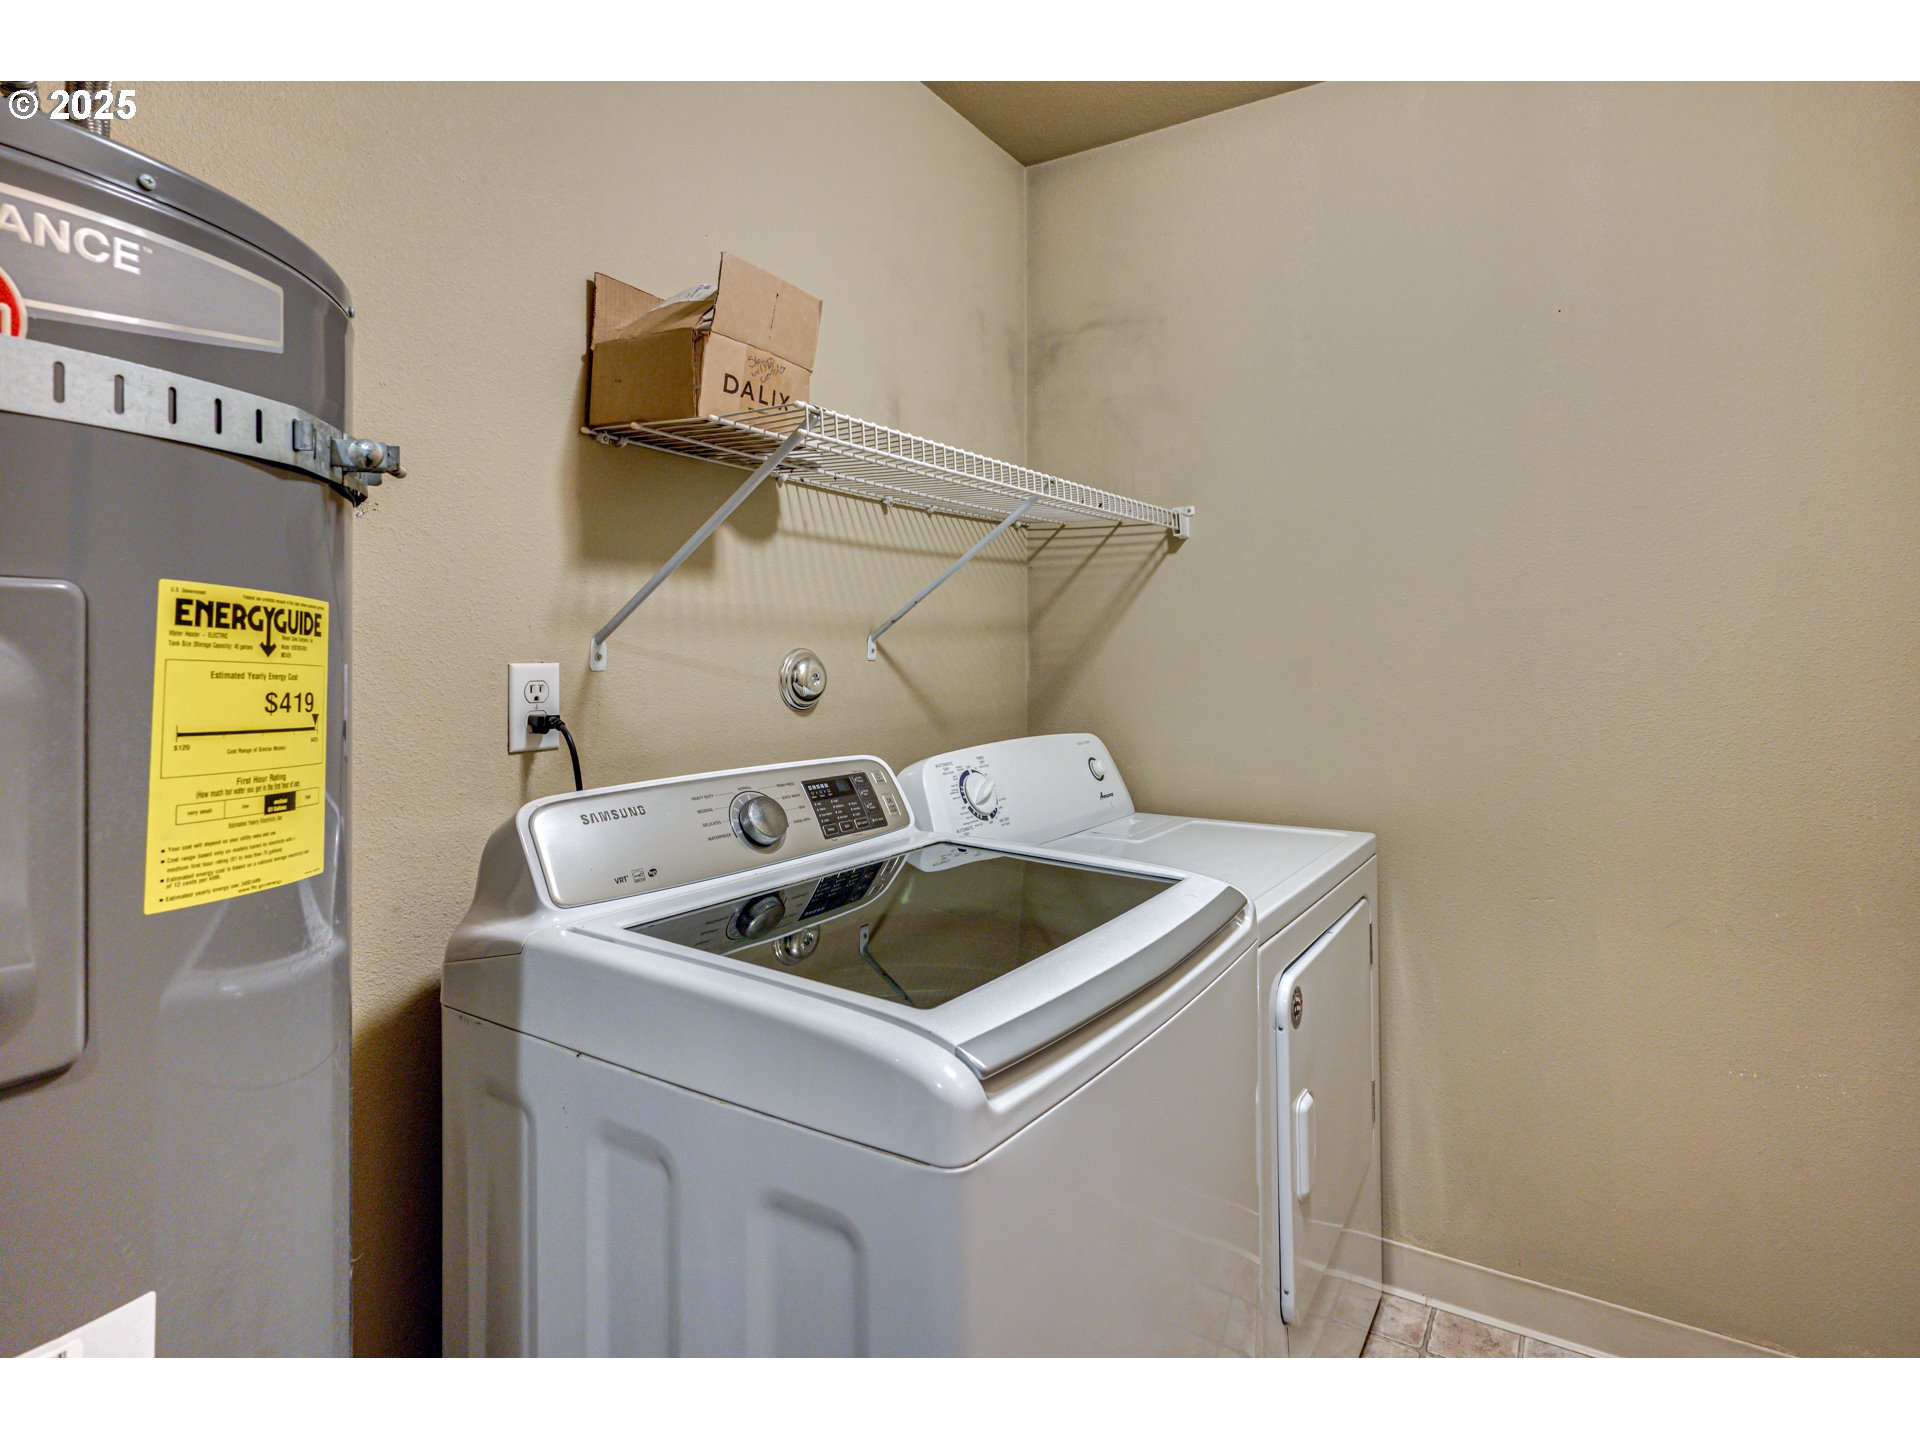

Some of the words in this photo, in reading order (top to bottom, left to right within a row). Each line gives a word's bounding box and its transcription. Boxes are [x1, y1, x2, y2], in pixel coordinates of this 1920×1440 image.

[723, 373, 791, 411] DALIX
[173, 597, 322, 638] ENERGYGUIDE
[211, 671, 245, 680] Estimated
[248, 672, 267, 681] Yearly
[268, 673, 286, 682] Energy
[288, 673, 298, 681] Cost
[264, 692, 314, 716] $419
[236, 777, 251, 785] First
[253, 775, 267, 783] Hour
[270, 773, 286, 783] Rating
[195, 791, 208, 799] (How
[210, 790, 224, 798] much
[580, 804, 647, 826] SAMSUNG
